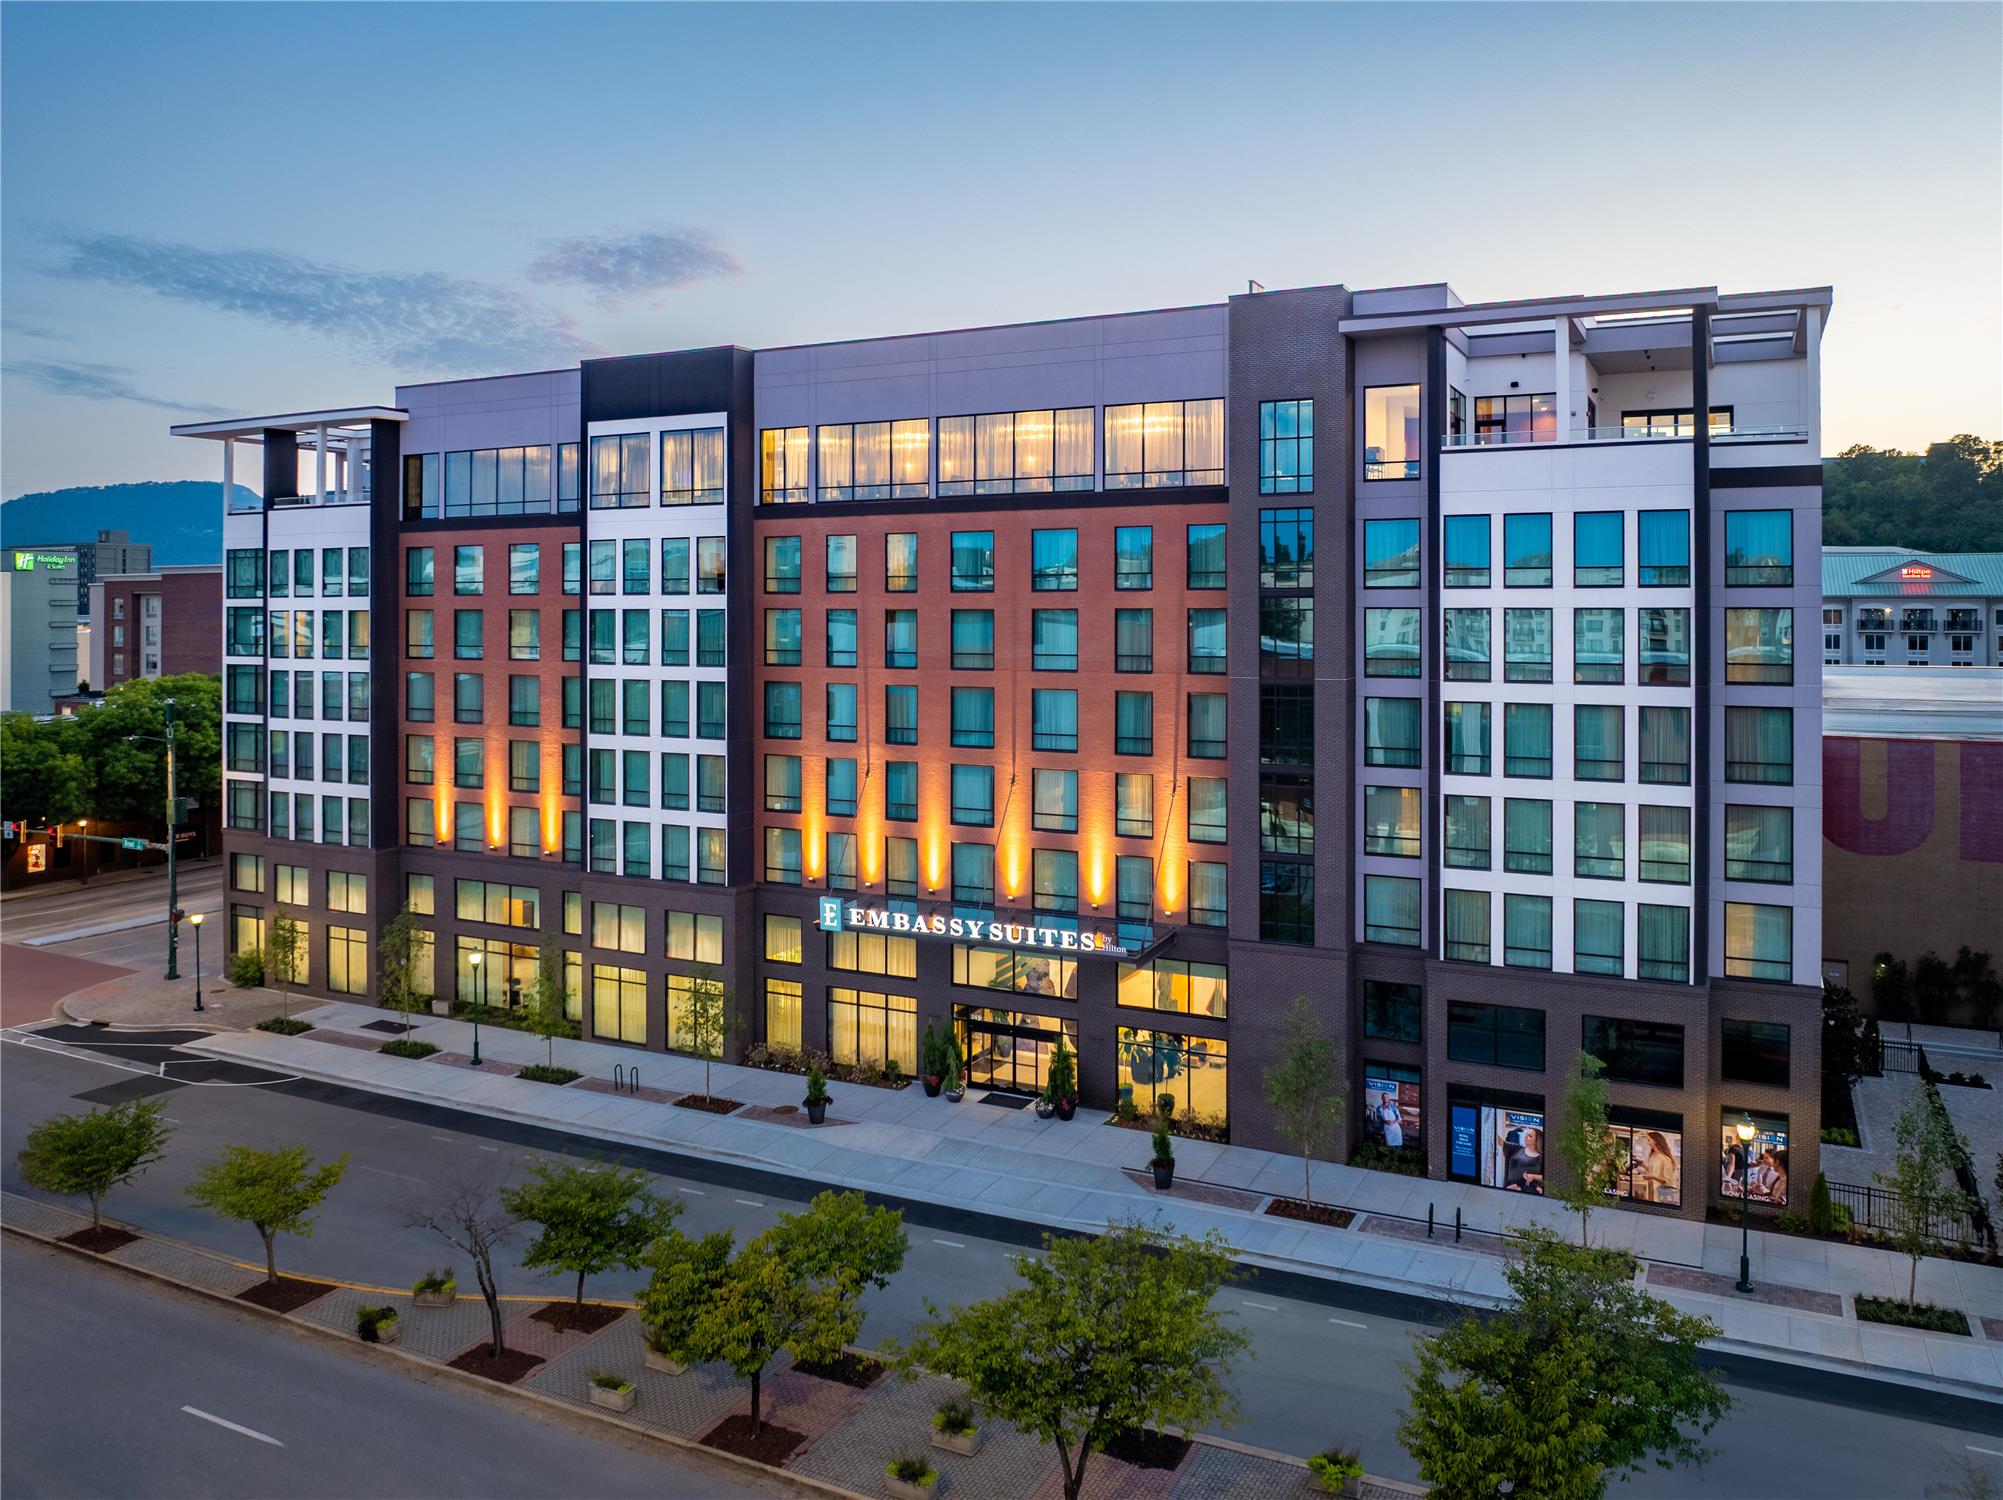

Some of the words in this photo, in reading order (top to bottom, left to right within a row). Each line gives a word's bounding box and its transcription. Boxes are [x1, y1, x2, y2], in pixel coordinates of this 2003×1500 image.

[37, 554, 64, 564] Holiday
[64, 555, 76, 563] Inn
[848, 908, 985, 939] EMBASSY
[989, 923, 1095, 951] SUITES
[1103, 934, 1113, 944] by
[1103, 944, 1127, 953] Hilton
[1510, 1114, 1540, 1123] VISION
[1603, 1188, 1629, 1197] EASING
